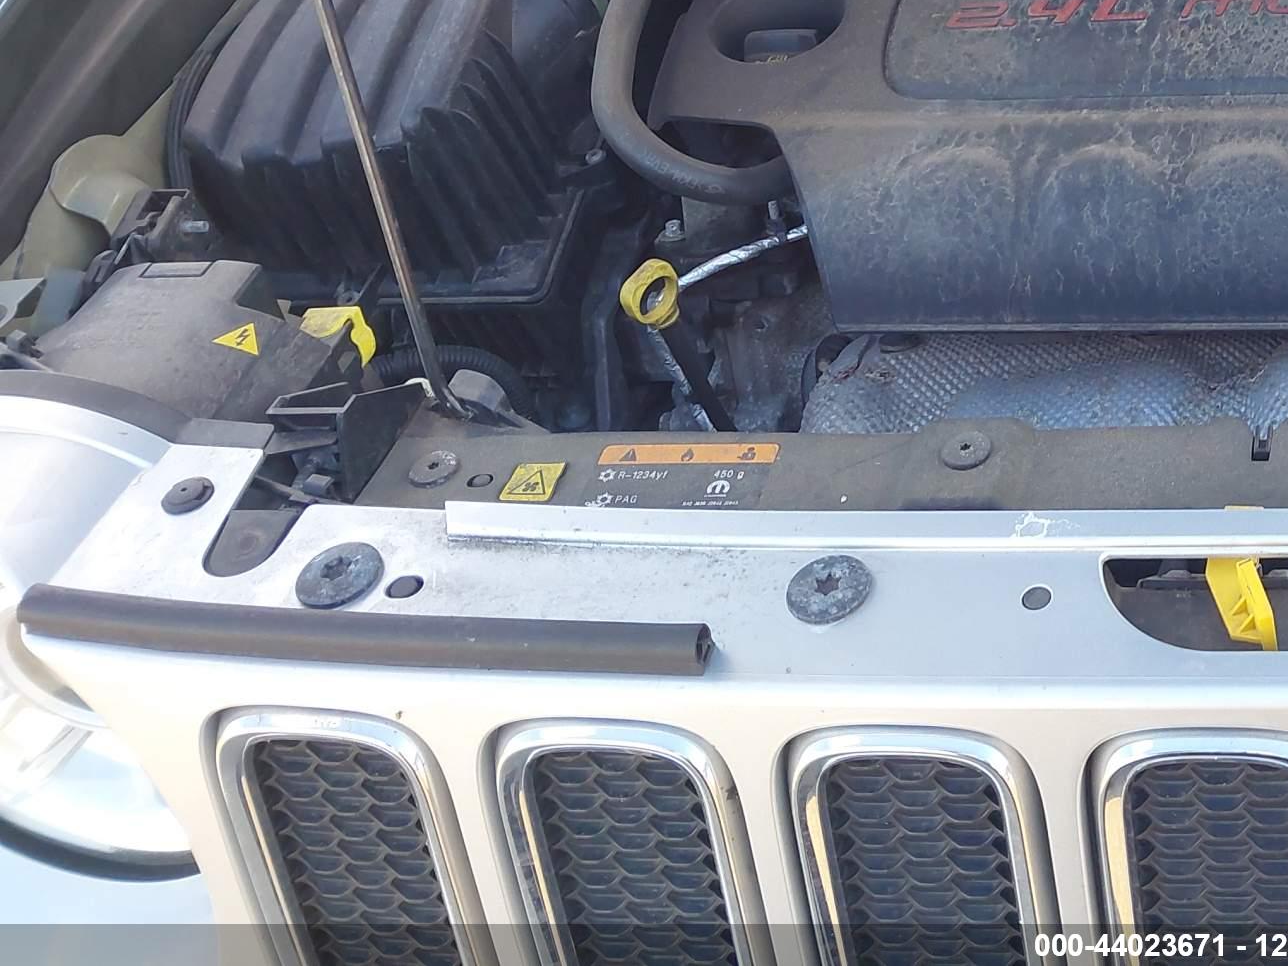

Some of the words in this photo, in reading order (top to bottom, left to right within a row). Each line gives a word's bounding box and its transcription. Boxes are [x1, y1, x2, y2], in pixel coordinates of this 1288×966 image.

[617, 470, 668, 480] R-1234yf
[713, 469, 734, 480] 450
[614, 494, 638, 504] PAG
